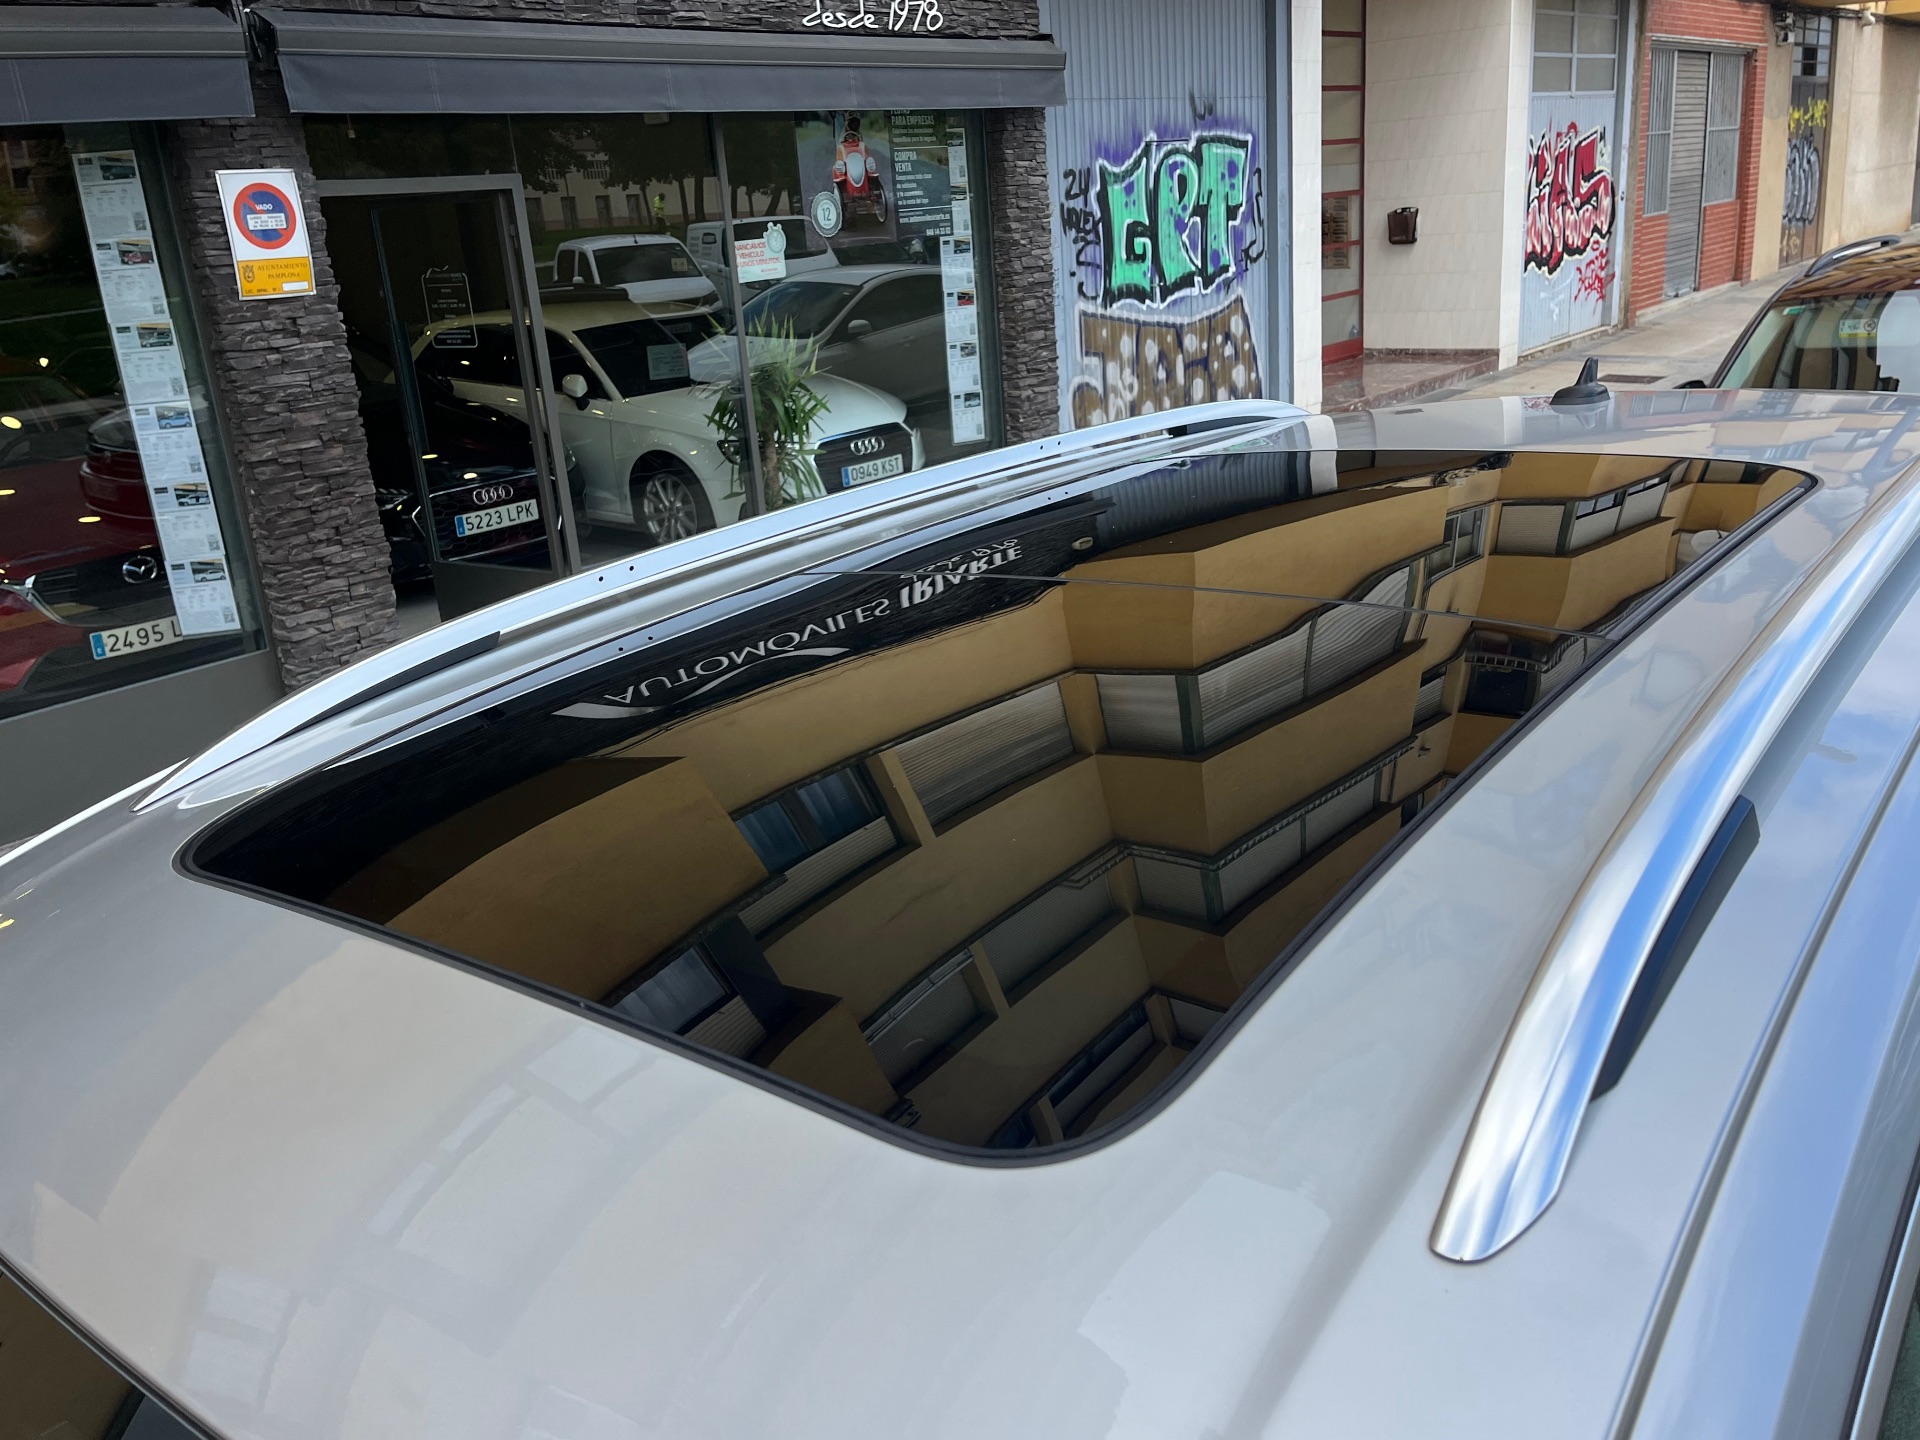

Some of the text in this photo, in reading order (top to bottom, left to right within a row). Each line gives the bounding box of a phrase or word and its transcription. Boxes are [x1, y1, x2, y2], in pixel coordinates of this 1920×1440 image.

[802, 0, 943, 31] desde 1978
[894, 151, 918, 162] COMPRA
[895, 162, 912, 172] VENTA
[255, 203, 273, 211] VADO
[822, 207, 831, 221] 12
[257, 262, 308, 271] AYUNTAMIENTO
[850, 456, 901, 482] 0949 KST
[464, 502, 534, 531] 5223 LPK
[106, 622, 164, 653] 2495
